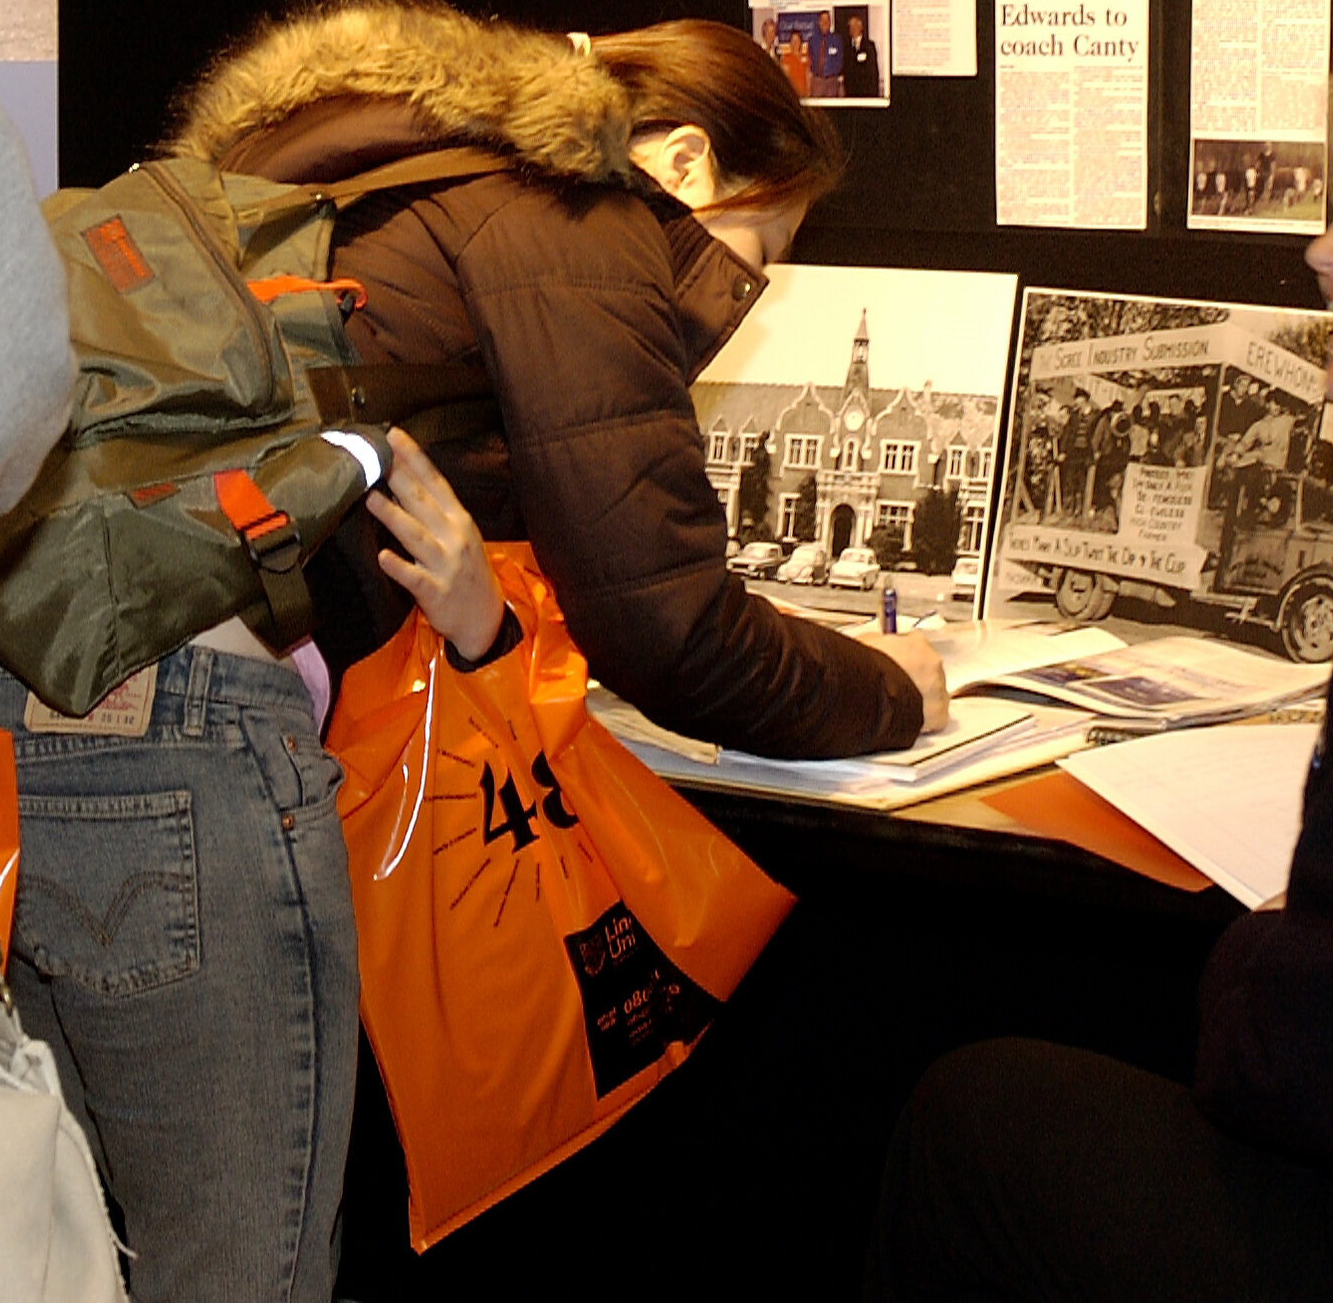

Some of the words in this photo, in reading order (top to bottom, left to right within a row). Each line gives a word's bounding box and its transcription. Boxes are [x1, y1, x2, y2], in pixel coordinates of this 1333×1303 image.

[1000, 3, 1096, 27] Edwards
[1105, 7, 1128, 27] to
[1000, 33, 1064, 57] coach
[1073, 33, 1139, 63] Canty
